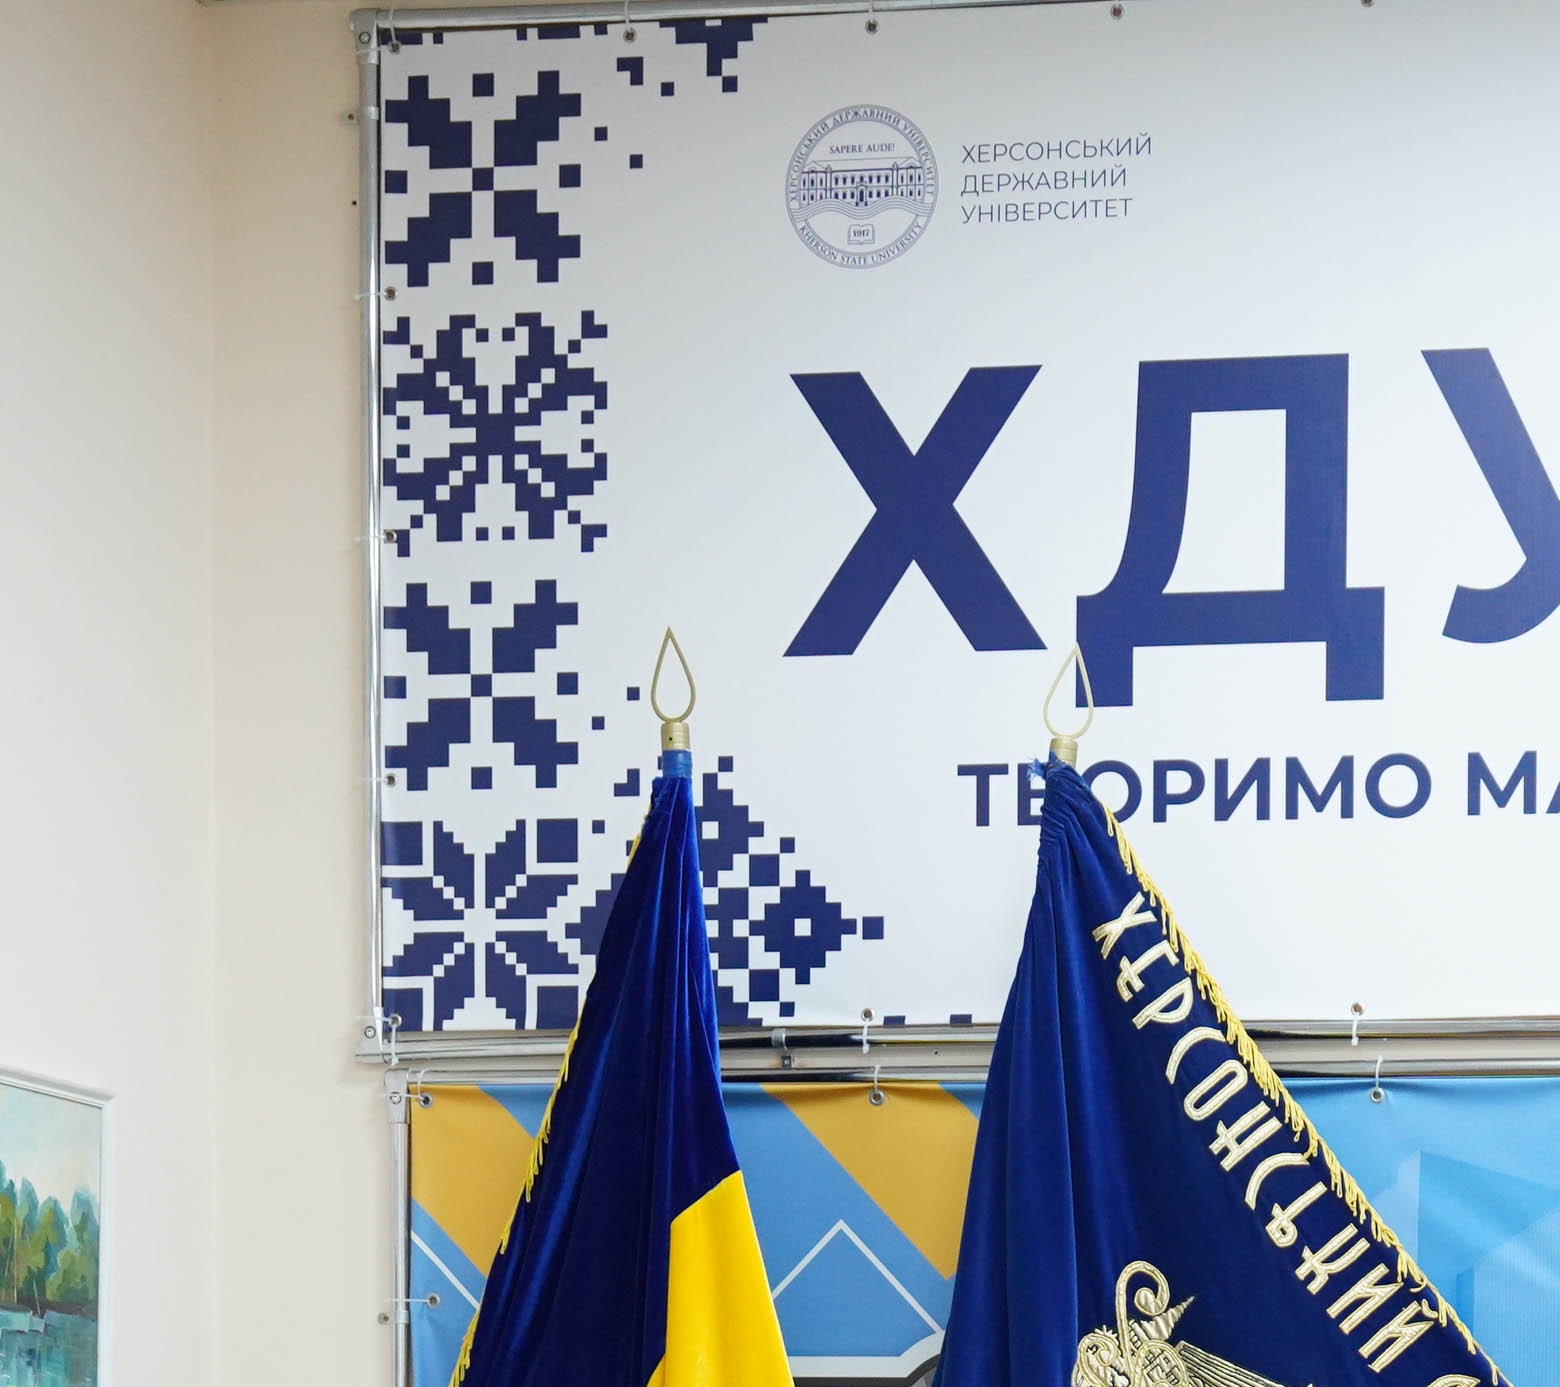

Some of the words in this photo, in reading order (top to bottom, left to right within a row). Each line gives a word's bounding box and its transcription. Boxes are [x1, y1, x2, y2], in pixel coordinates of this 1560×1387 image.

[829, 144, 863, 154] SAPERE
[961, 132, 1152, 163] ХЕРСОНСЬКИЙ
[960, 164, 1127, 197] ДЕРЖАВНИЙ
[960, 197, 1134, 224] УНІВЕРСИТЕТ
[799, 225, 838, 261] KHERSON
[841, 255, 868, 265] STATE
[871, 221, 923, 264] UNIVERSITY
[852, 229, 871, 238] 1917
[1093, 890, 1449, 1374] ХЕРСОНСЬКИЙ
